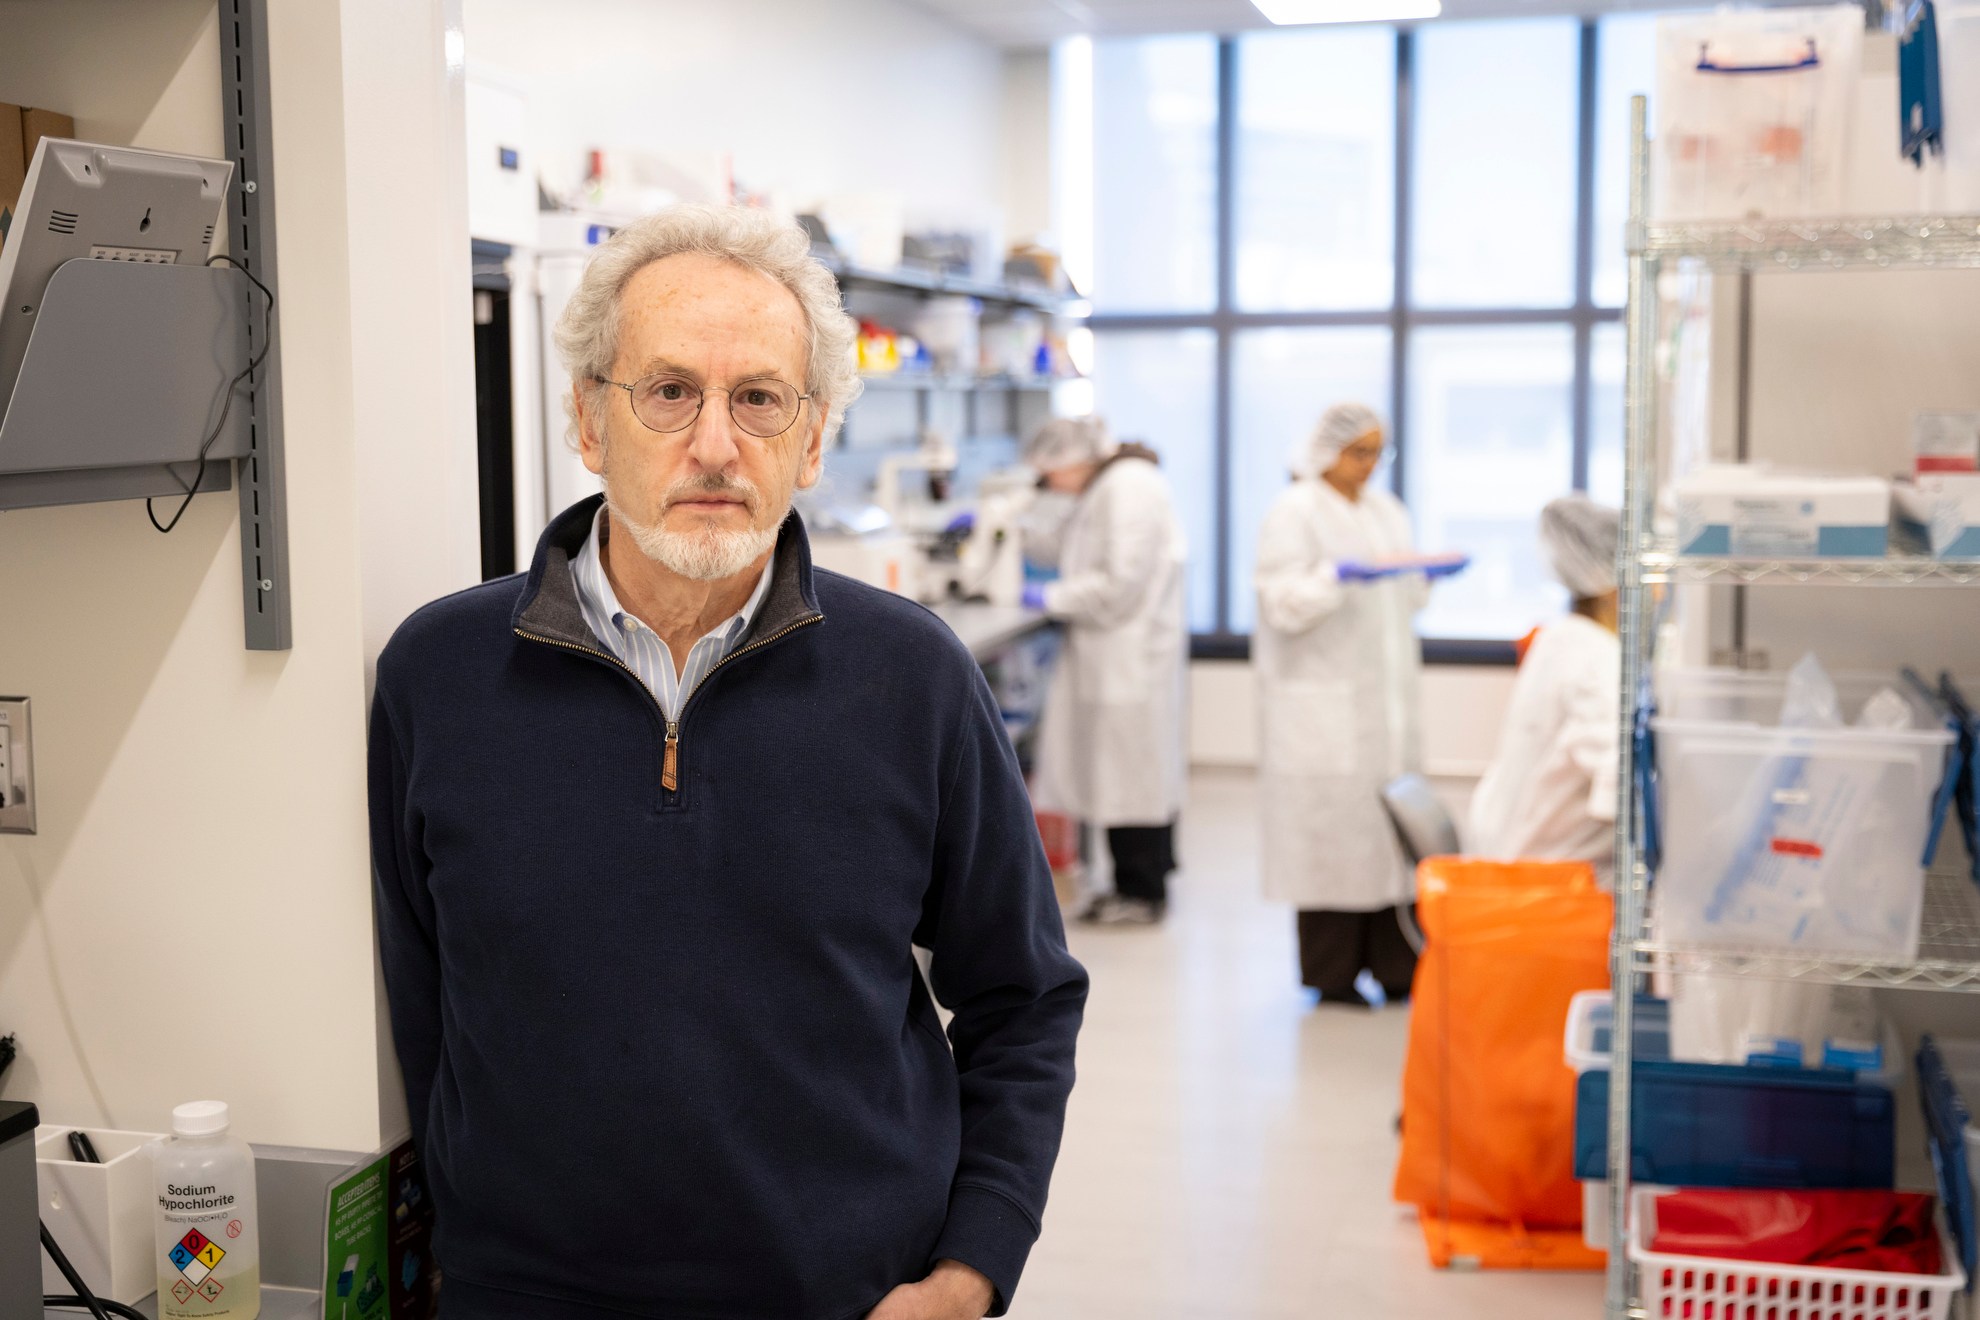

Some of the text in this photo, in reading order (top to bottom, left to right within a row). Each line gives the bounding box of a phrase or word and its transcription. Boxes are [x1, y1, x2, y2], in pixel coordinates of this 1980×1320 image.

[168, 1184, 215, 1196] Sodium
[337, 1182, 364, 1208] ACCEPTED
[159, 1195, 234, 1211] Hypochlorite
[189, 1234, 200, 1250] 0
[175, 1249, 185, 1265] 2
[205, 1248, 213, 1262] 1
